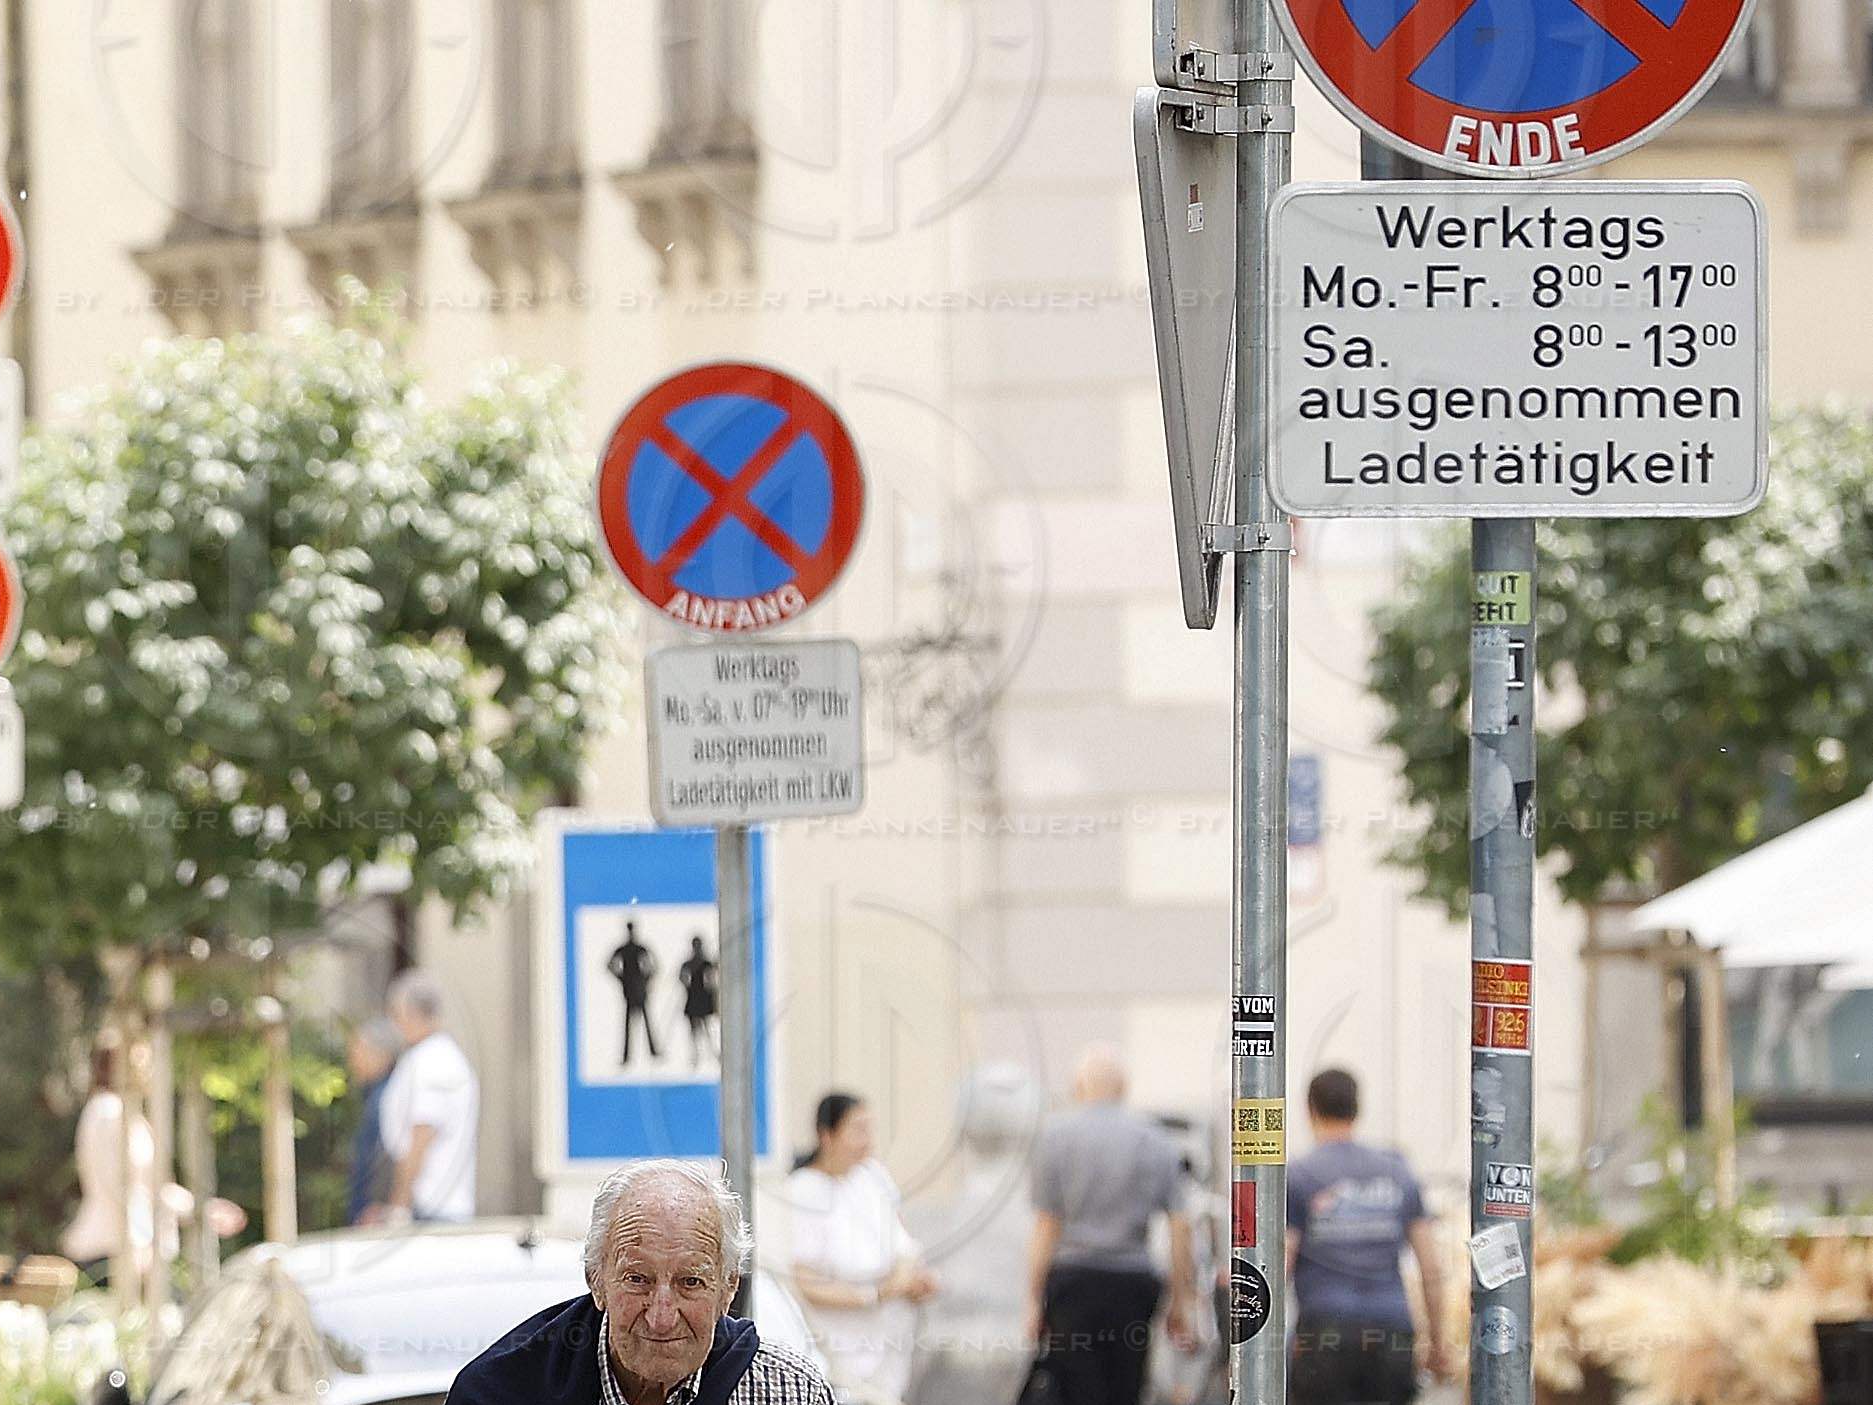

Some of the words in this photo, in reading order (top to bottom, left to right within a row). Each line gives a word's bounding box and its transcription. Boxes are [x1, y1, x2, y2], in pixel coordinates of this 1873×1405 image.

[1443, 113, 1586, 167] ENDE
[1375, 205, 1665, 261] Werktags
[1302, 265, 1500, 309] Mo.-Fr.
[1302, 323, 1390, 369] Sa.
[1298, 386, 1741, 431] ausgenommen
[1323, 440, 1715, 496] Ladetätigkeit
[715, 653, 801, 688] Werktags
[693, 731, 828, 770] ausgenommen
[669, 770, 780, 813] Ladetätigkeit
[786, 769, 815, 801] mit
[820, 768, 853, 799] LKW
[1241, 997, 1274, 1014] VOM
[1486, 1186, 1531, 1204] UNTEN
